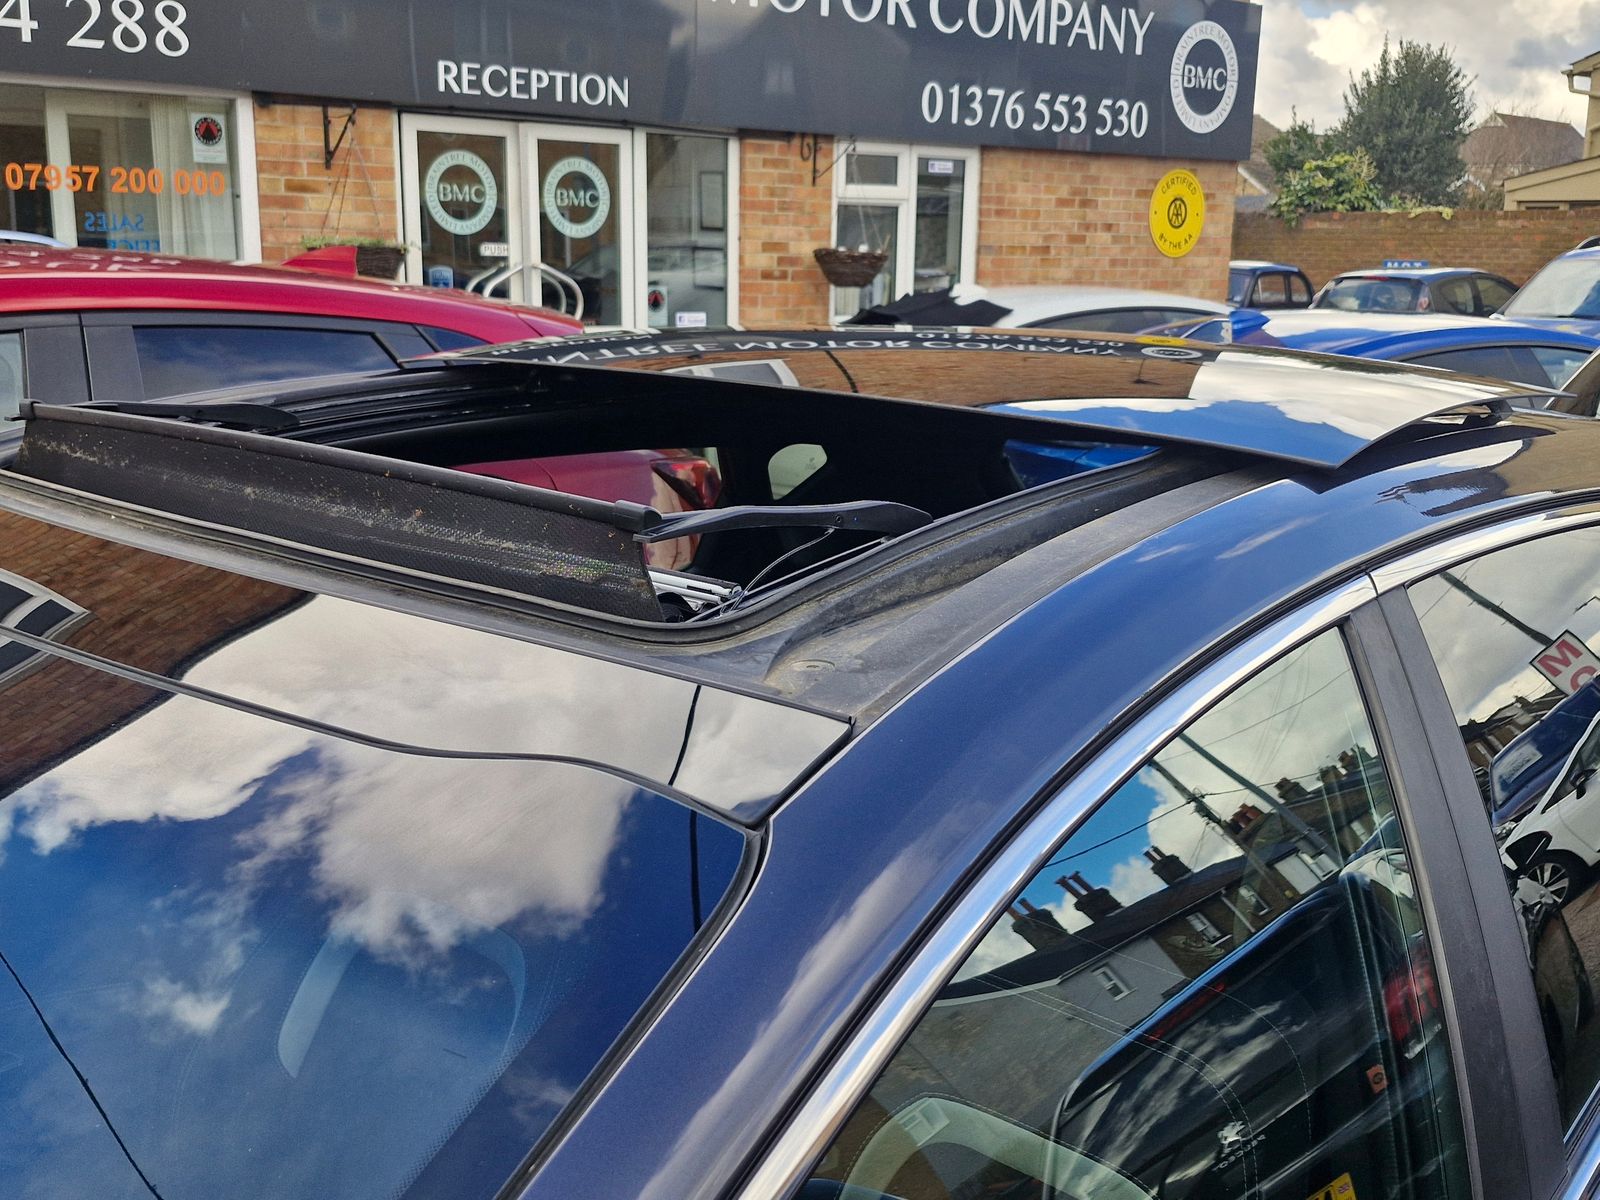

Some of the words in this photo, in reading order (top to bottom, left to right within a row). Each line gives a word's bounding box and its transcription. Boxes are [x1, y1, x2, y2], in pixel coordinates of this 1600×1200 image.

[65, 0, 190, 57] 288
[929, 0, 1155, 55] COMPANY
[437, 59, 629, 108] RECEPTION
[1183, 64, 1227, 92] BMC
[921, 80, 1025, 129] 01376
[1032, 92, 1087, 134] 553
[1095, 98, 1148, 138] 530
[5, 162, 100, 192] 07957
[110, 166, 164, 194] 200
[174, 170, 226, 196] 000
[439, 183, 485, 203] BMC
[1161, 176, 1197, 195] CERTIFIED
[556, 188, 600, 208] BMC
[483, 245, 509, 255] PUSH
[1159, 233, 1168, 243] BY
[1169, 241, 1182, 249] THE
[1184, 233, 1193, 245] AA
